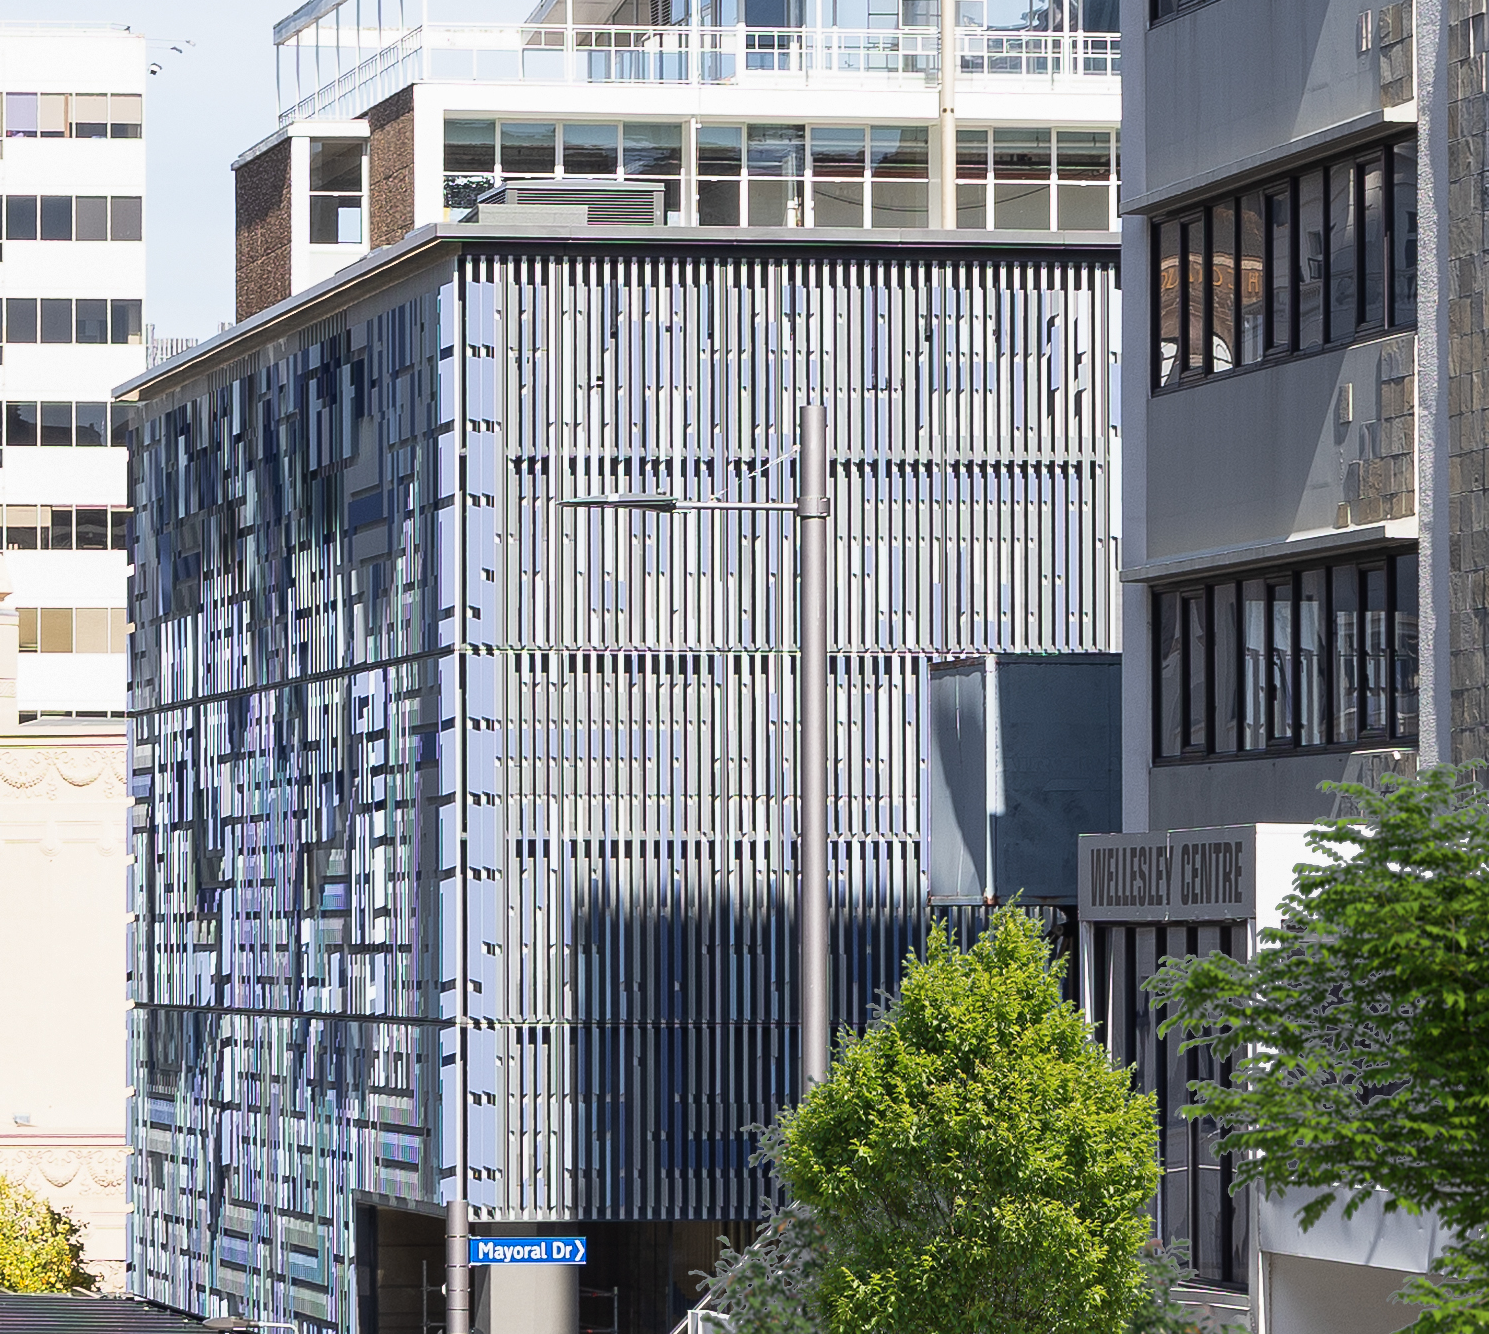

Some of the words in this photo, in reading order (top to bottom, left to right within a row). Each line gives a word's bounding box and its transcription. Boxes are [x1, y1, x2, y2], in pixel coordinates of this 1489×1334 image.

[1090, 846, 1174, 907] WELLESLEY
[1181, 841, 1243, 906] CENTRE
[478, 1241, 548, 1263] Mayoral
[552, 1241, 573, 1260] Dr
